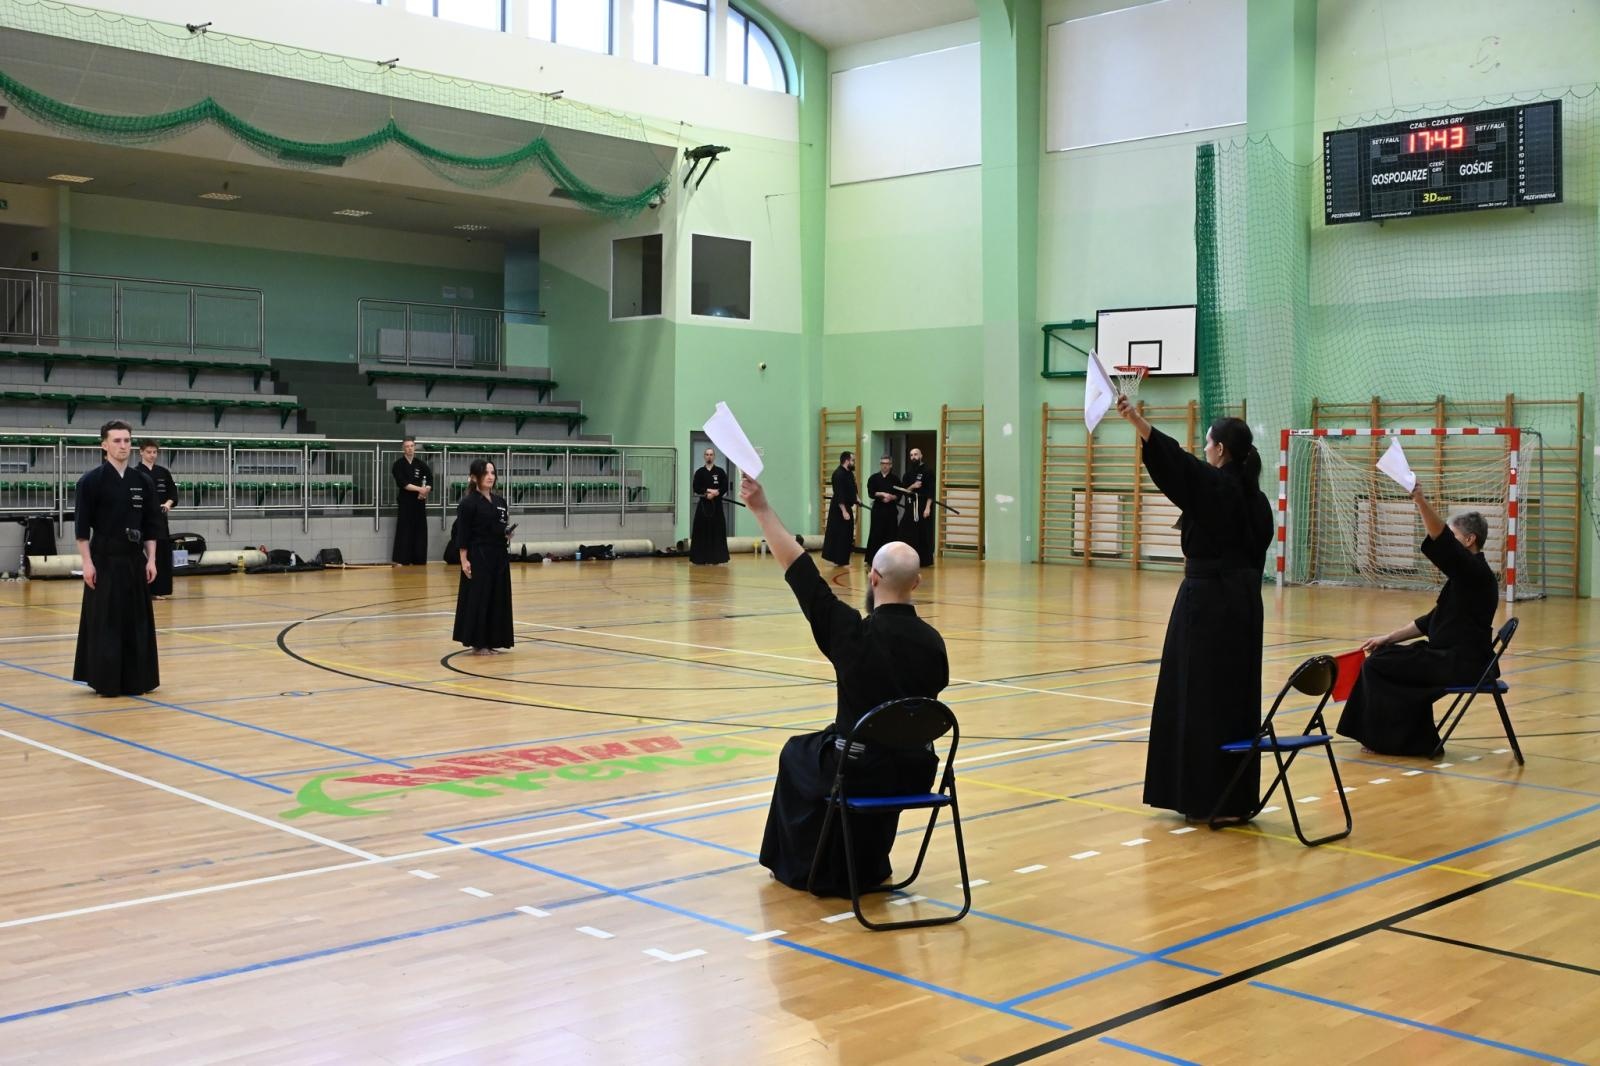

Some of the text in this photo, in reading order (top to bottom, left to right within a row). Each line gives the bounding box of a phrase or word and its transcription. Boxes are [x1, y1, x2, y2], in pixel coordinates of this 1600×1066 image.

[1409, 122, 1427, 130] CZAS
[1449, 116, 1464, 124] GRY
[1409, 126, 1465, 153] 17:43
[1459, 160, 1493, 176] GOŚCIE
[1371, 168, 1428, 185] GOSPODARZE
[1423, 192, 1437, 203] 3D
